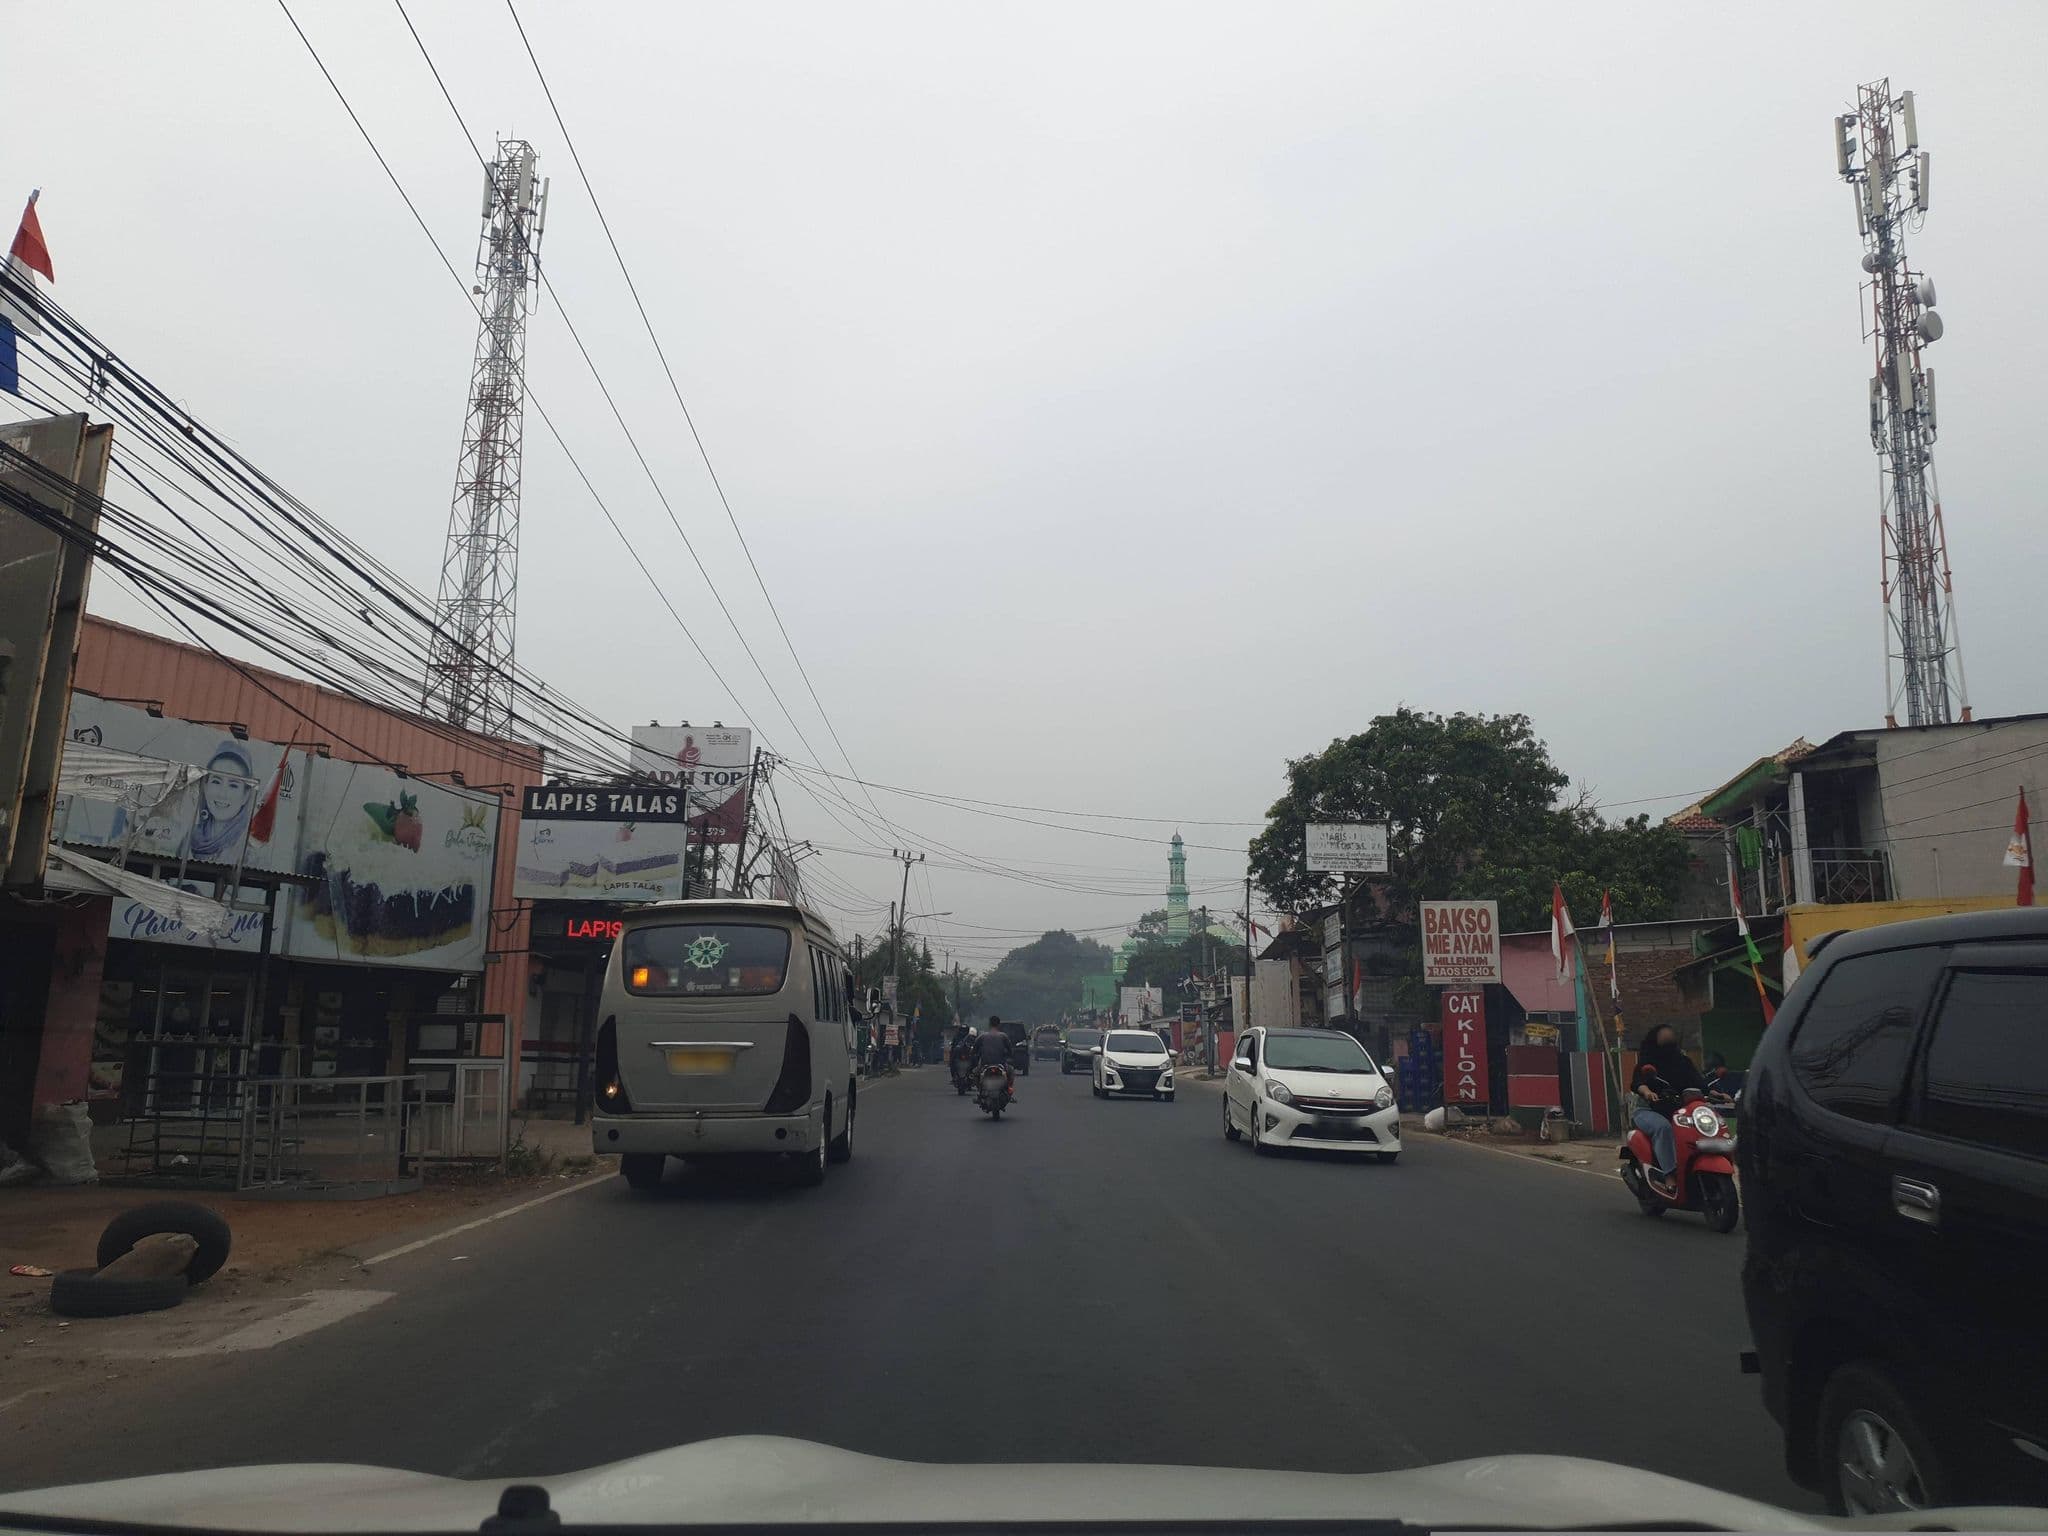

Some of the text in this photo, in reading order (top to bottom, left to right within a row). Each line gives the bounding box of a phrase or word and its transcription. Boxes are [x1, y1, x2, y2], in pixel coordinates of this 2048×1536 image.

[702, 771, 743, 786] TOP
[531, 792, 678, 814] LAPIS TALAS
[603, 881, 664, 893] LAPIS TALAS
[567, 919, 623, 938] LAPIS
[1424, 908, 1492, 934] BAKSO
[1426, 934, 1493, 954] MIE AYAM
[1433, 956, 1489, 966] MILLENIUM
[1432, 966, 1490, 976] RAOS ECHO
[1448, 995, 1480, 1014] CAT
[1456, 1018, 1477, 1099] KILOAN
